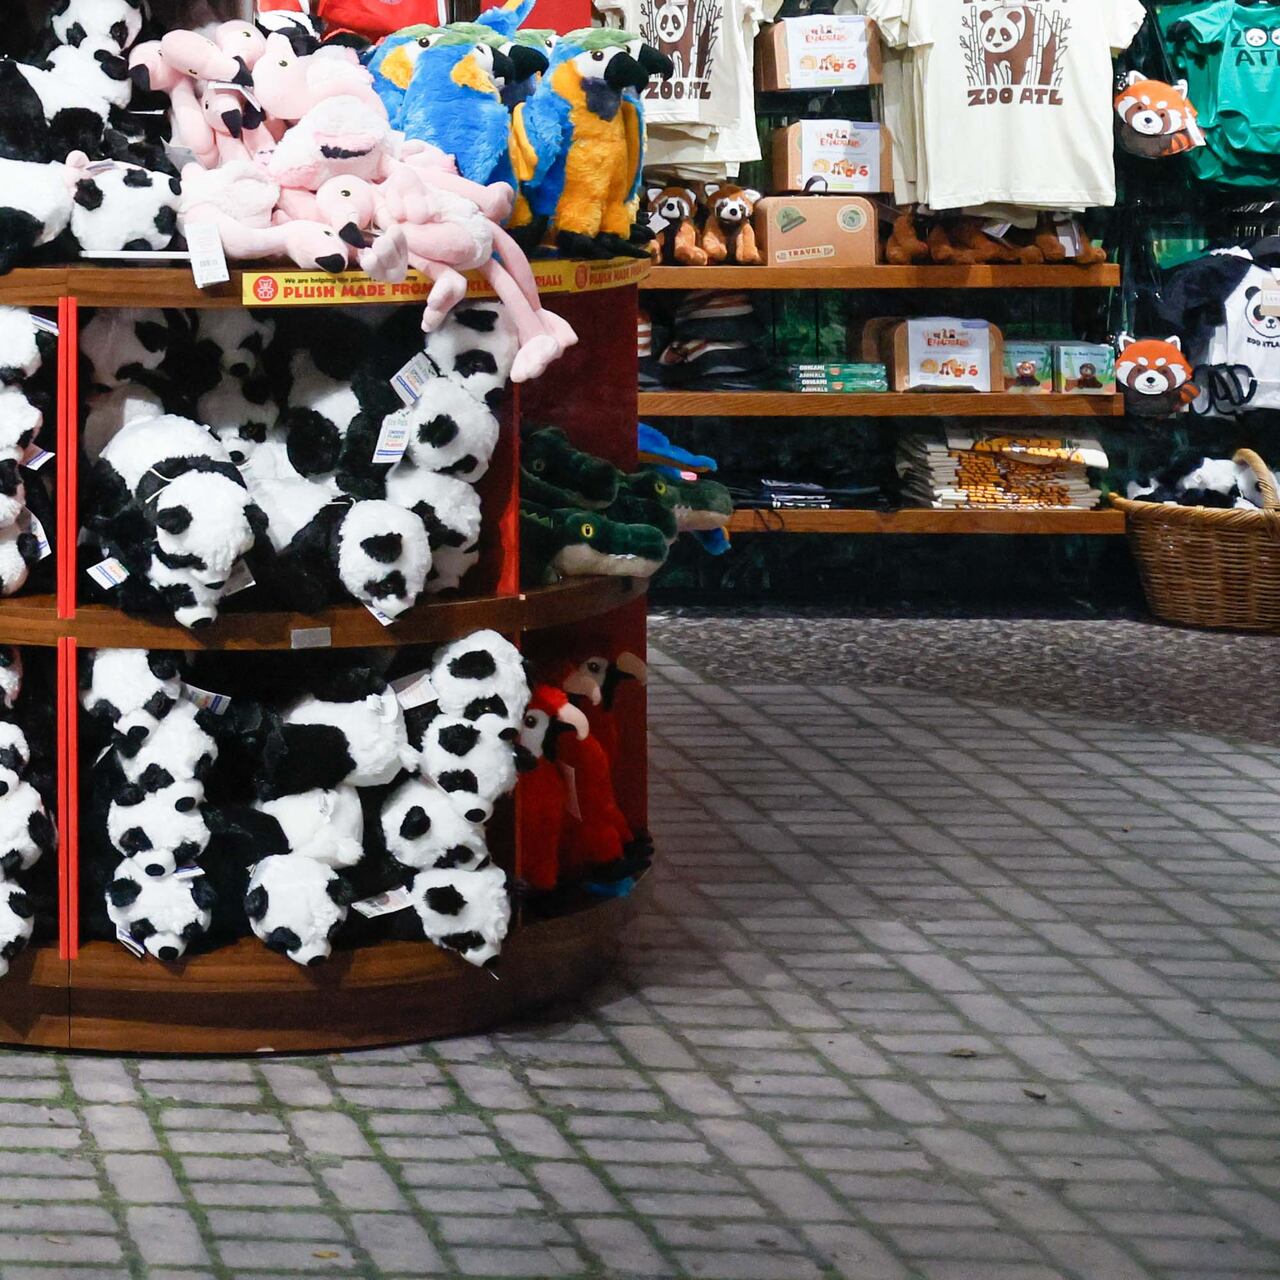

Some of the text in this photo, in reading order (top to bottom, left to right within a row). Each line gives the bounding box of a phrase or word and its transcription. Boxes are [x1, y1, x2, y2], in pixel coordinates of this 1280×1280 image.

[645, 81, 685, 100] ZOO
[967, 87, 1064, 107] ZOO ATL
[788, 247, 822, 258] TRAVEL
[283, 285, 336, 299] PLUSH
[340, 283, 386, 297] MADE
